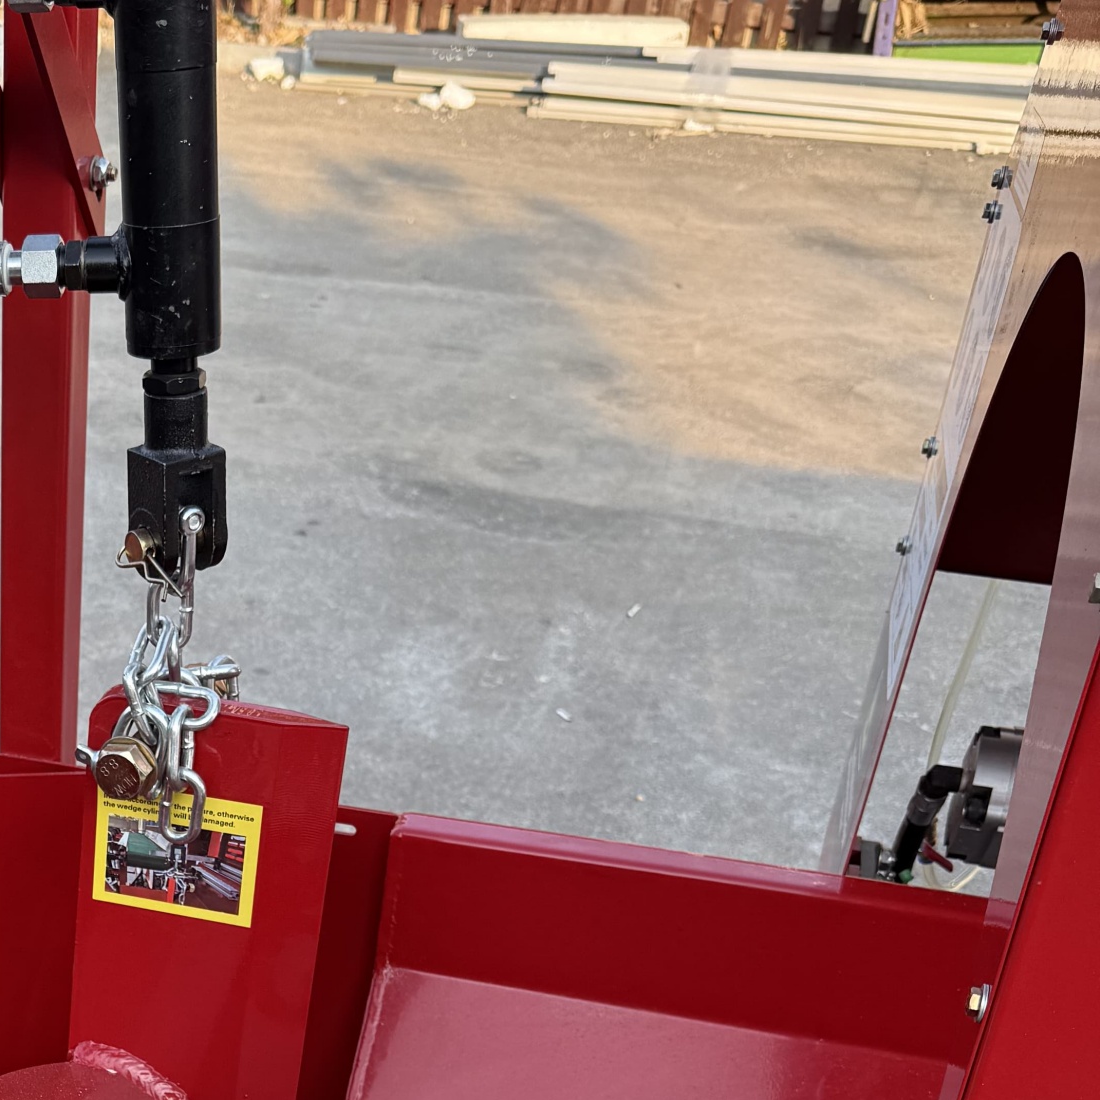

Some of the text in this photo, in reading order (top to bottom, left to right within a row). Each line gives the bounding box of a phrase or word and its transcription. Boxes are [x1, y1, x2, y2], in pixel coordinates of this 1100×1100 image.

[117, 803, 141, 812] wedge
[202, 818, 235, 828] amaged.
[174, 803, 186, 811] the
[217, 810, 254, 822] otherwise
